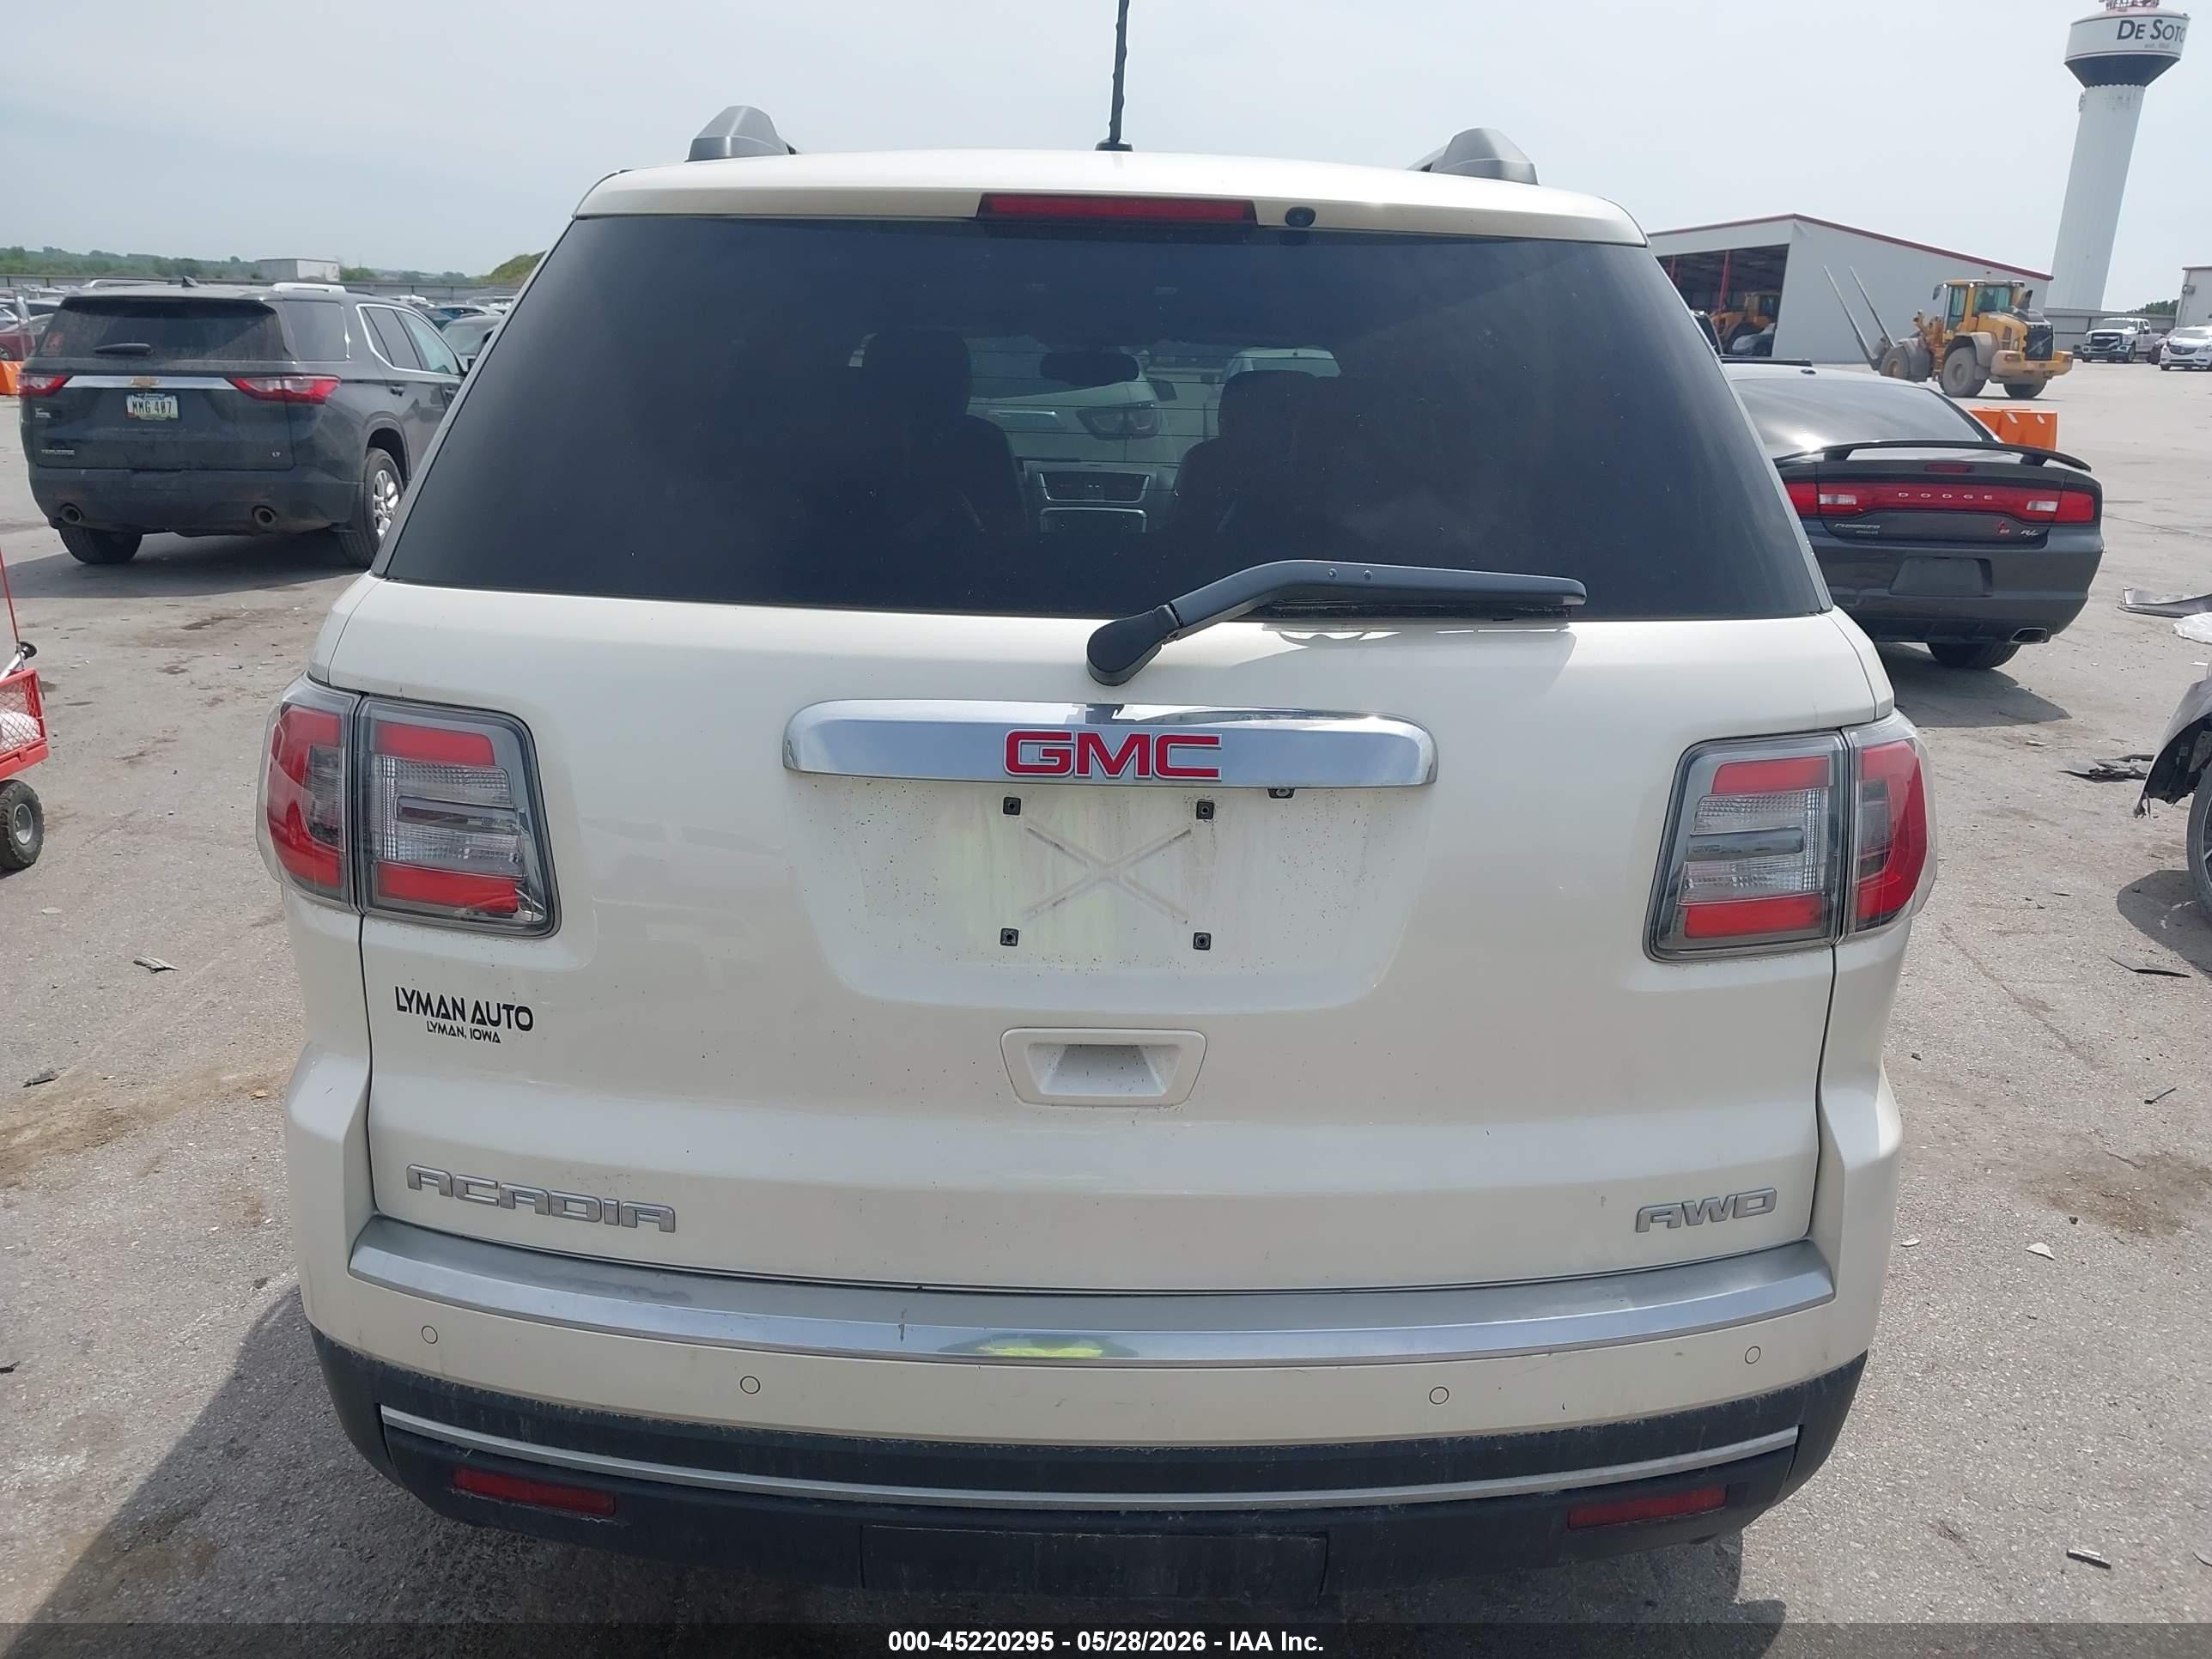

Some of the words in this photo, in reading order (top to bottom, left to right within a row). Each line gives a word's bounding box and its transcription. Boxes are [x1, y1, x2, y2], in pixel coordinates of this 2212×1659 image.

[132, 400, 151, 413] MMG
[1003, 730, 1222, 781] GMC
[395, 986, 466, 1023] LYMAN
[471, 1000, 534, 1032] AUTO
[427, 1020, 467, 1039] LYMAN,
[470, 1028, 501, 1044] IOWA
[405, 1164, 676, 1234] ACADIA
[1635, 1188, 1778, 1233] AWD
